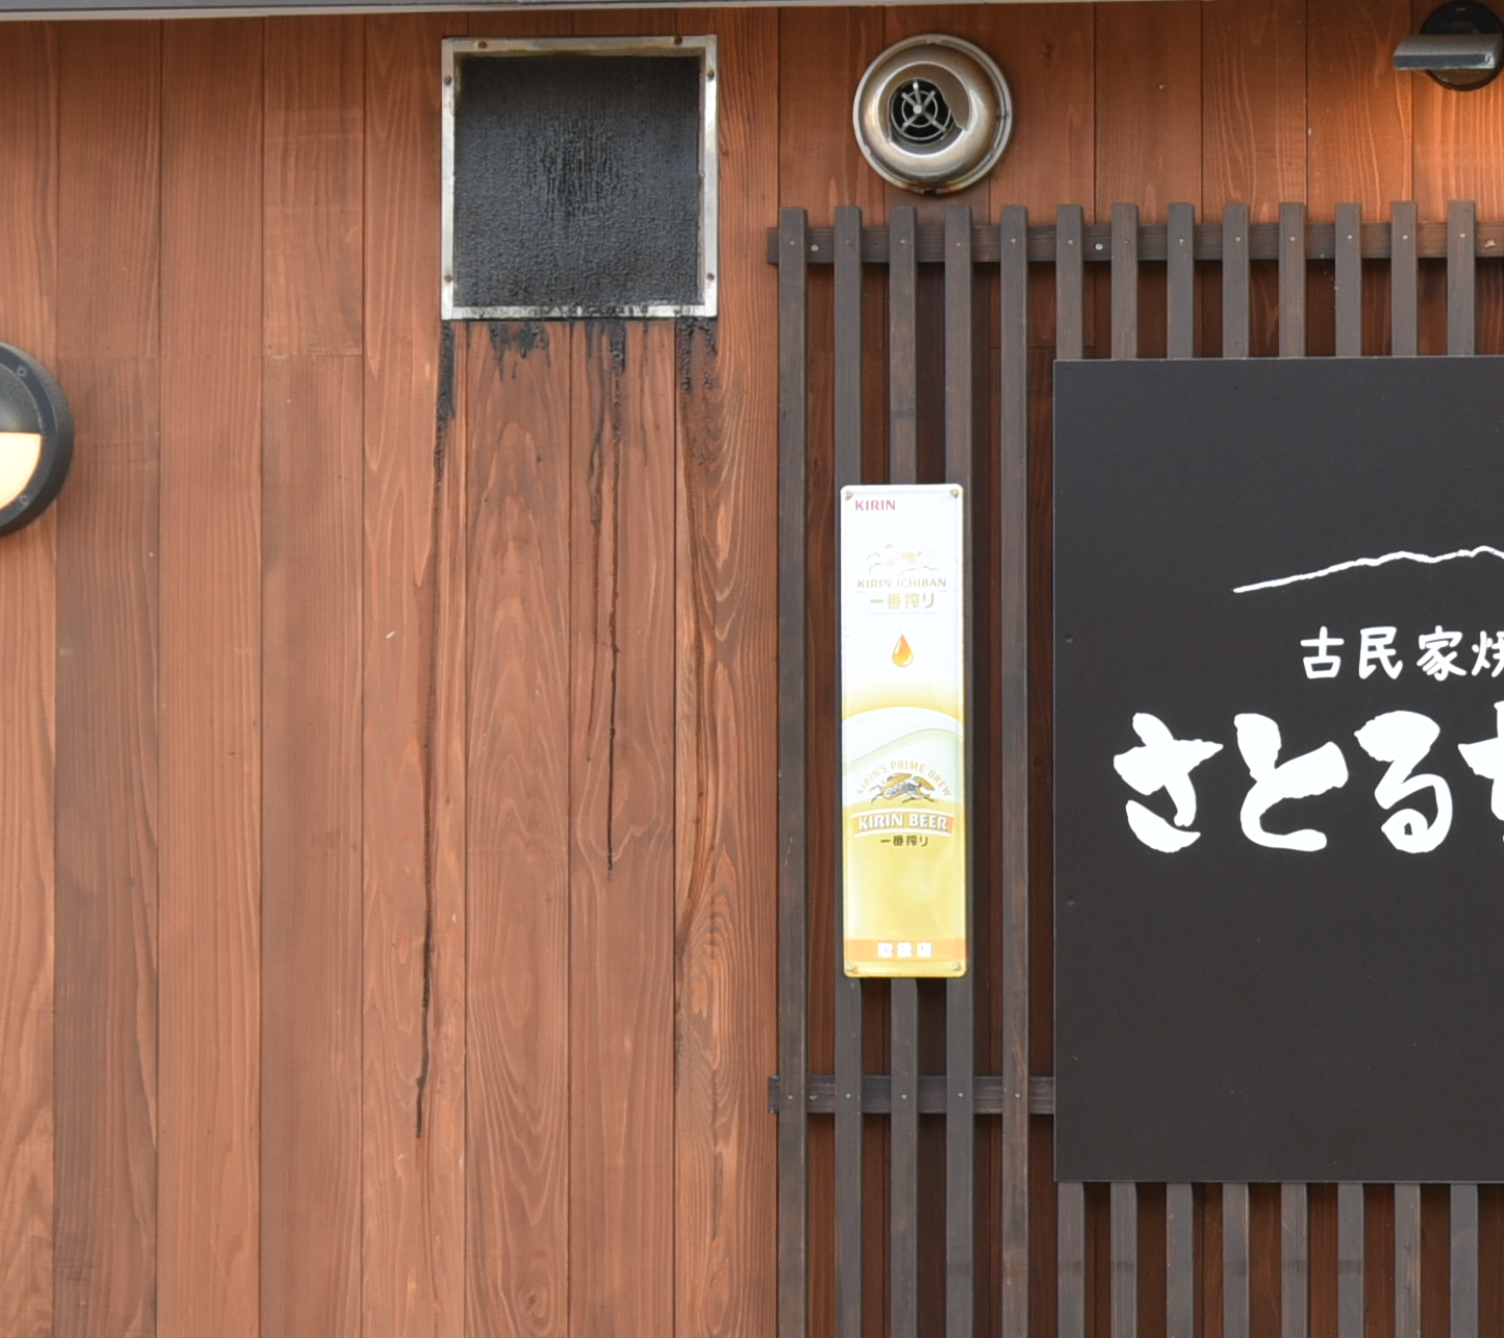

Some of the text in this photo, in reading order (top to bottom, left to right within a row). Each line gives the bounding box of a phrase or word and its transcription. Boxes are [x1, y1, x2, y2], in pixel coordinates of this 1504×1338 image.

[855, 499, 896, 511] KIRIN
[857, 577, 947, 589] KIRIN ICHIBAN
[869, 592, 935, 610] 一番搾り
[856, 760, 952, 797] KIRIN'S PRIME BREW
[858, 812, 948, 831] KIRIN BEER
